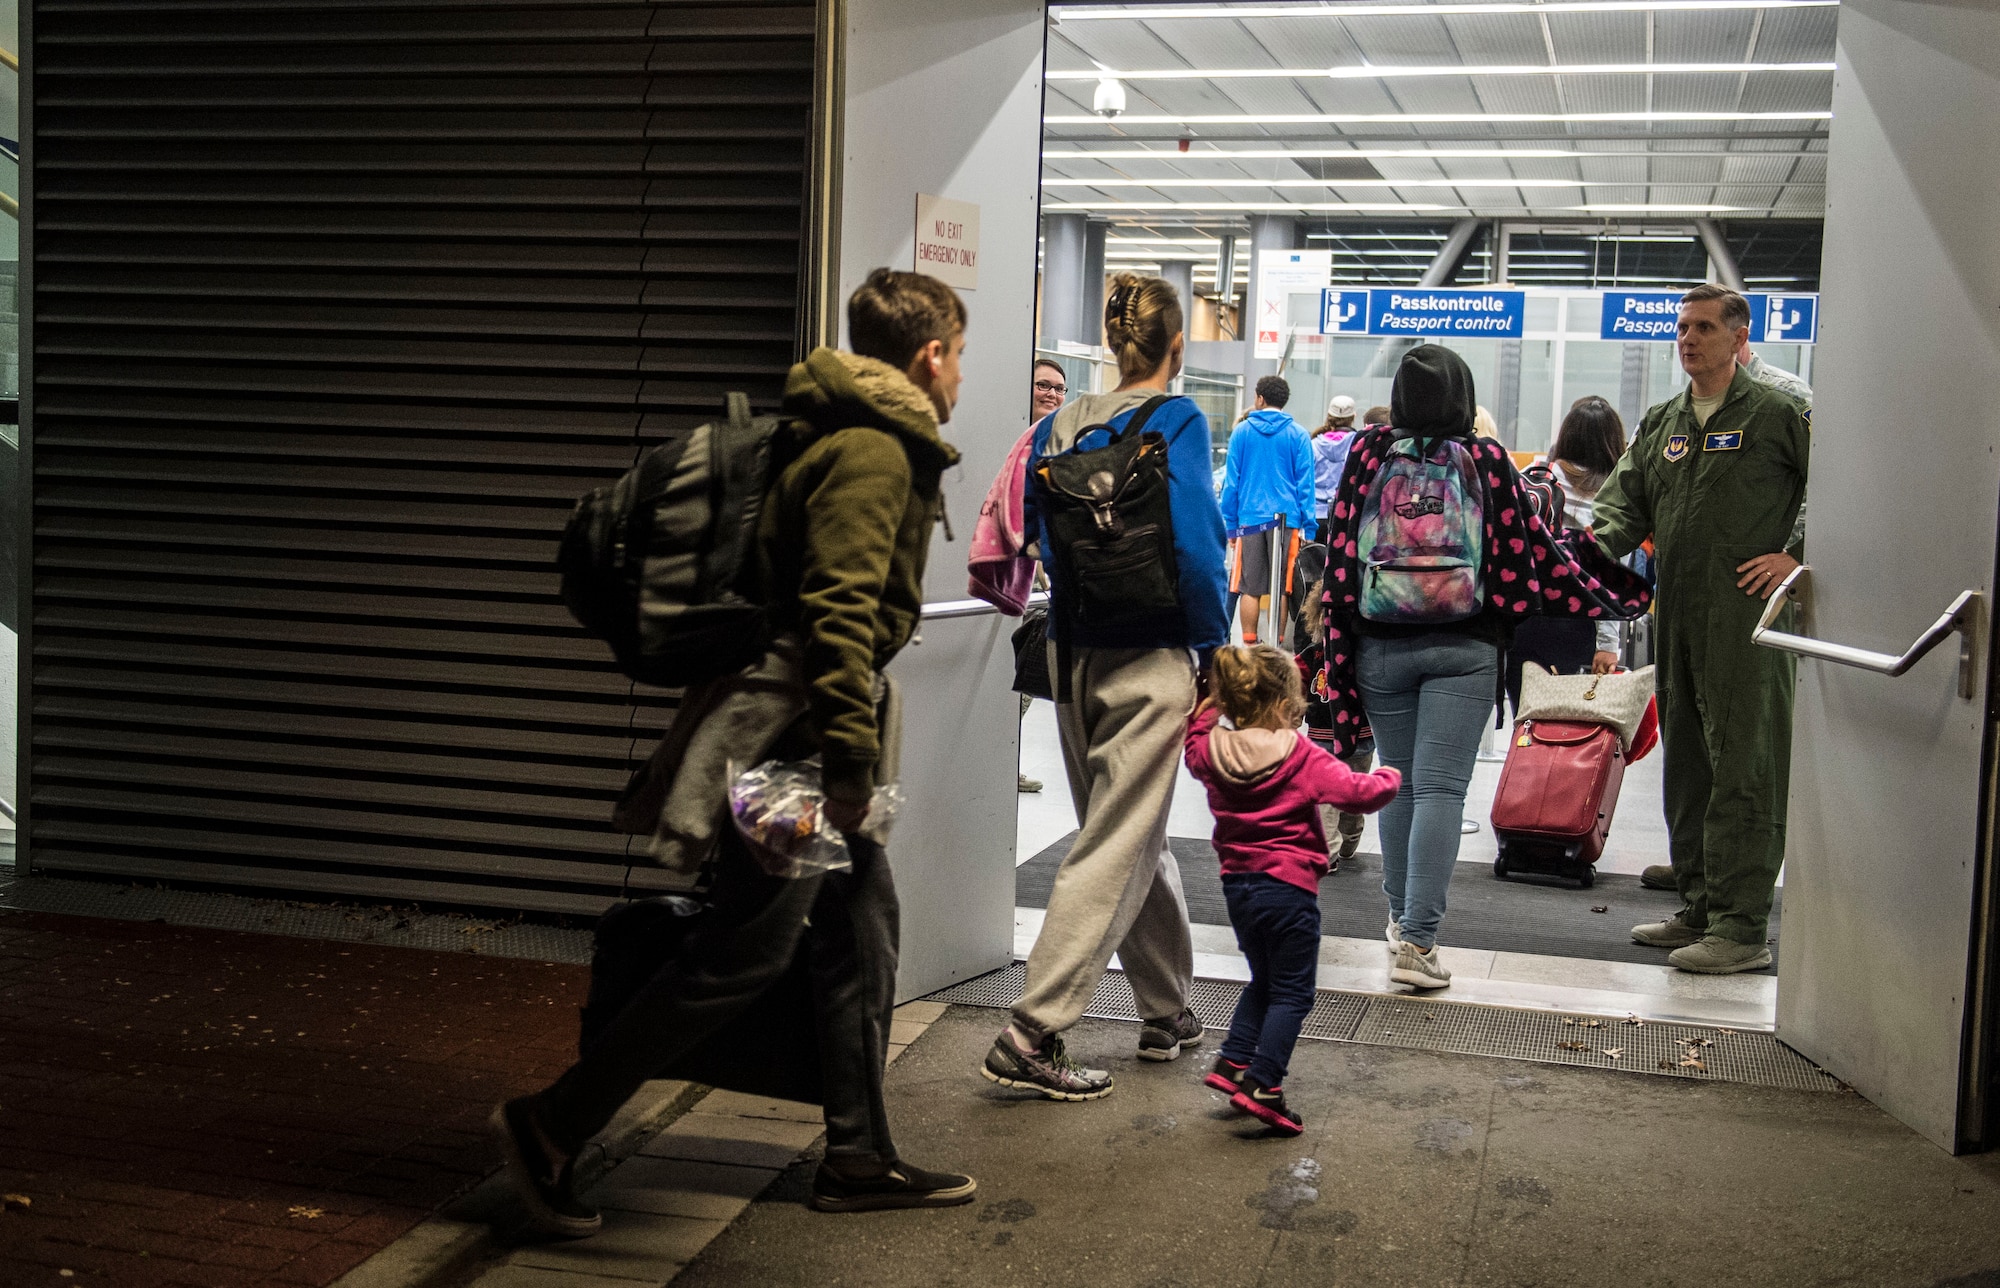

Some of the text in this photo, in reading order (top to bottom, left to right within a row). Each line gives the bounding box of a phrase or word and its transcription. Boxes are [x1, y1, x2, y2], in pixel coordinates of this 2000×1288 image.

[935, 220, 963, 240] NO EXIT
[920, 242, 976, 267] EMERGENCY ONLY
[1390, 294, 1504, 312] Passkontrolle
[1624, 297, 1683, 315] Passko
[1380, 313, 1513, 332] Passport control
[1612, 316, 1678, 337] Passpor
